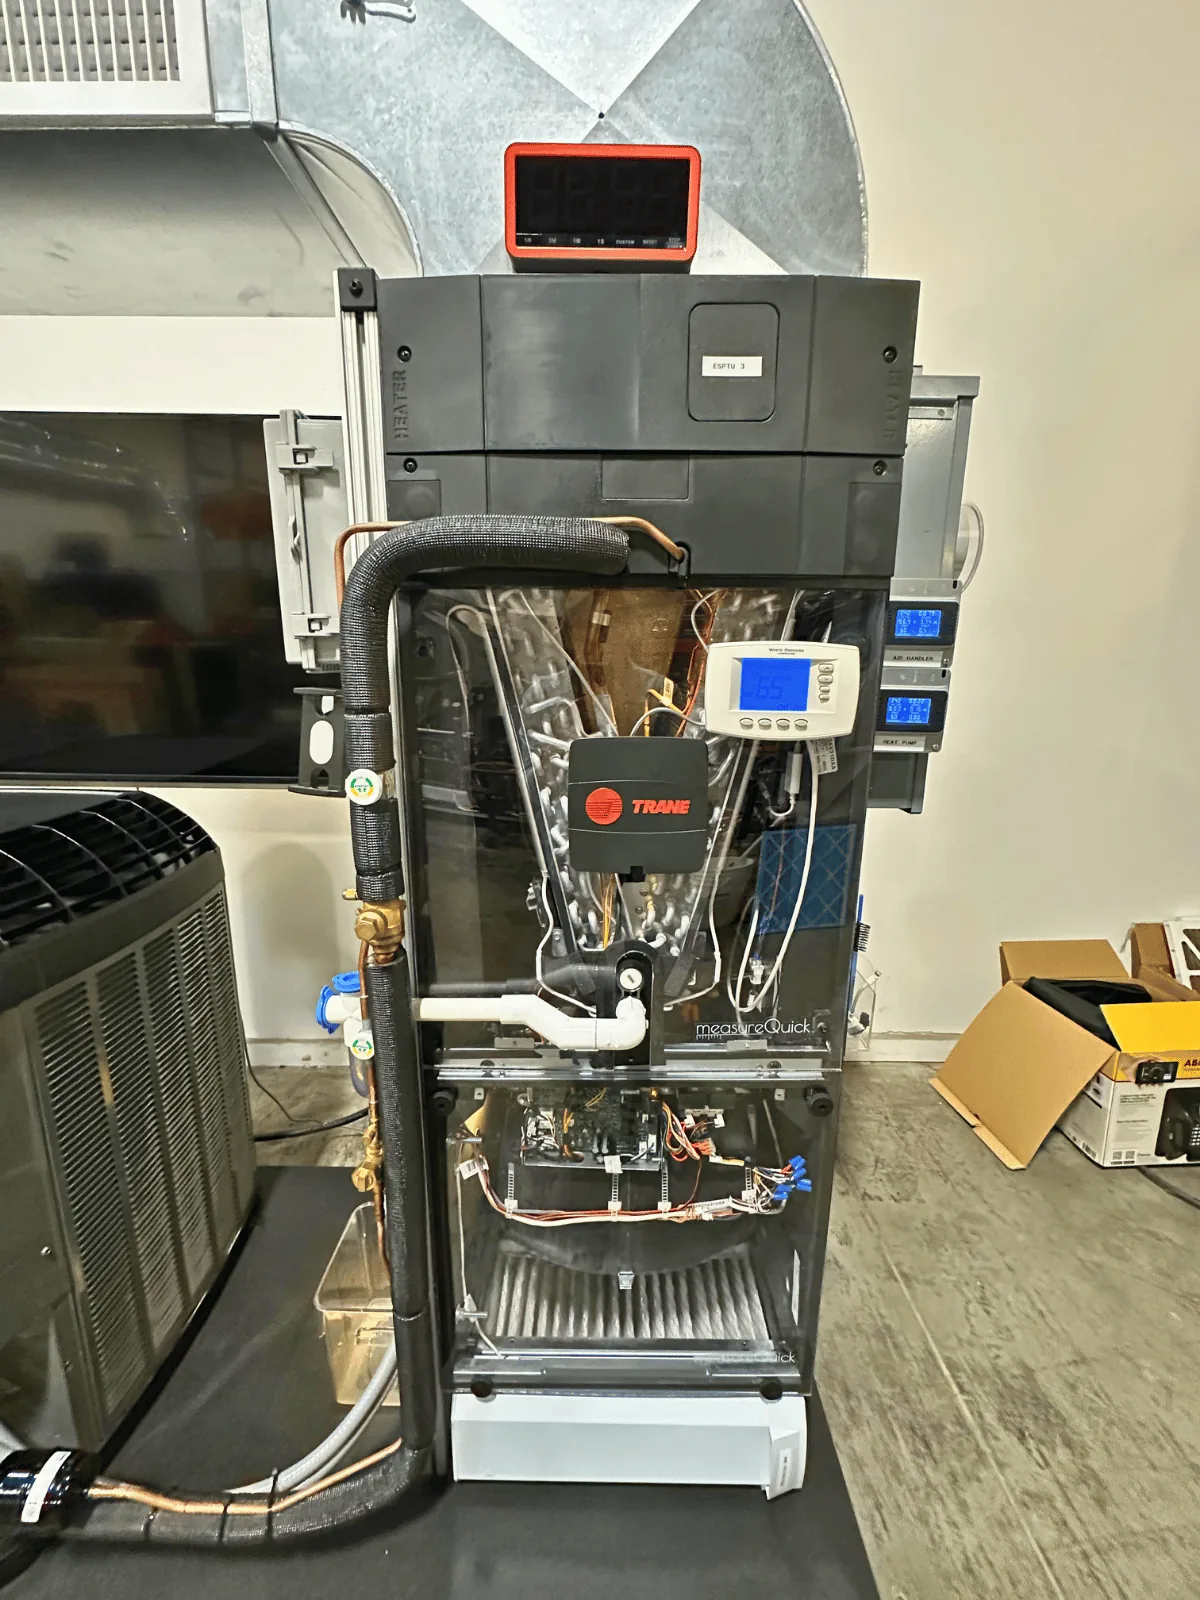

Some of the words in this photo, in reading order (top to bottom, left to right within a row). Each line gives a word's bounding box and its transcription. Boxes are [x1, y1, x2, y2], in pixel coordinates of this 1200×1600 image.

[392, 369, 409, 439] HEATER
[632, 799, 691, 815] TRANE
[696, 1018, 811, 1034] measureQuick
[1183, 1059, 1200, 1067] AB
